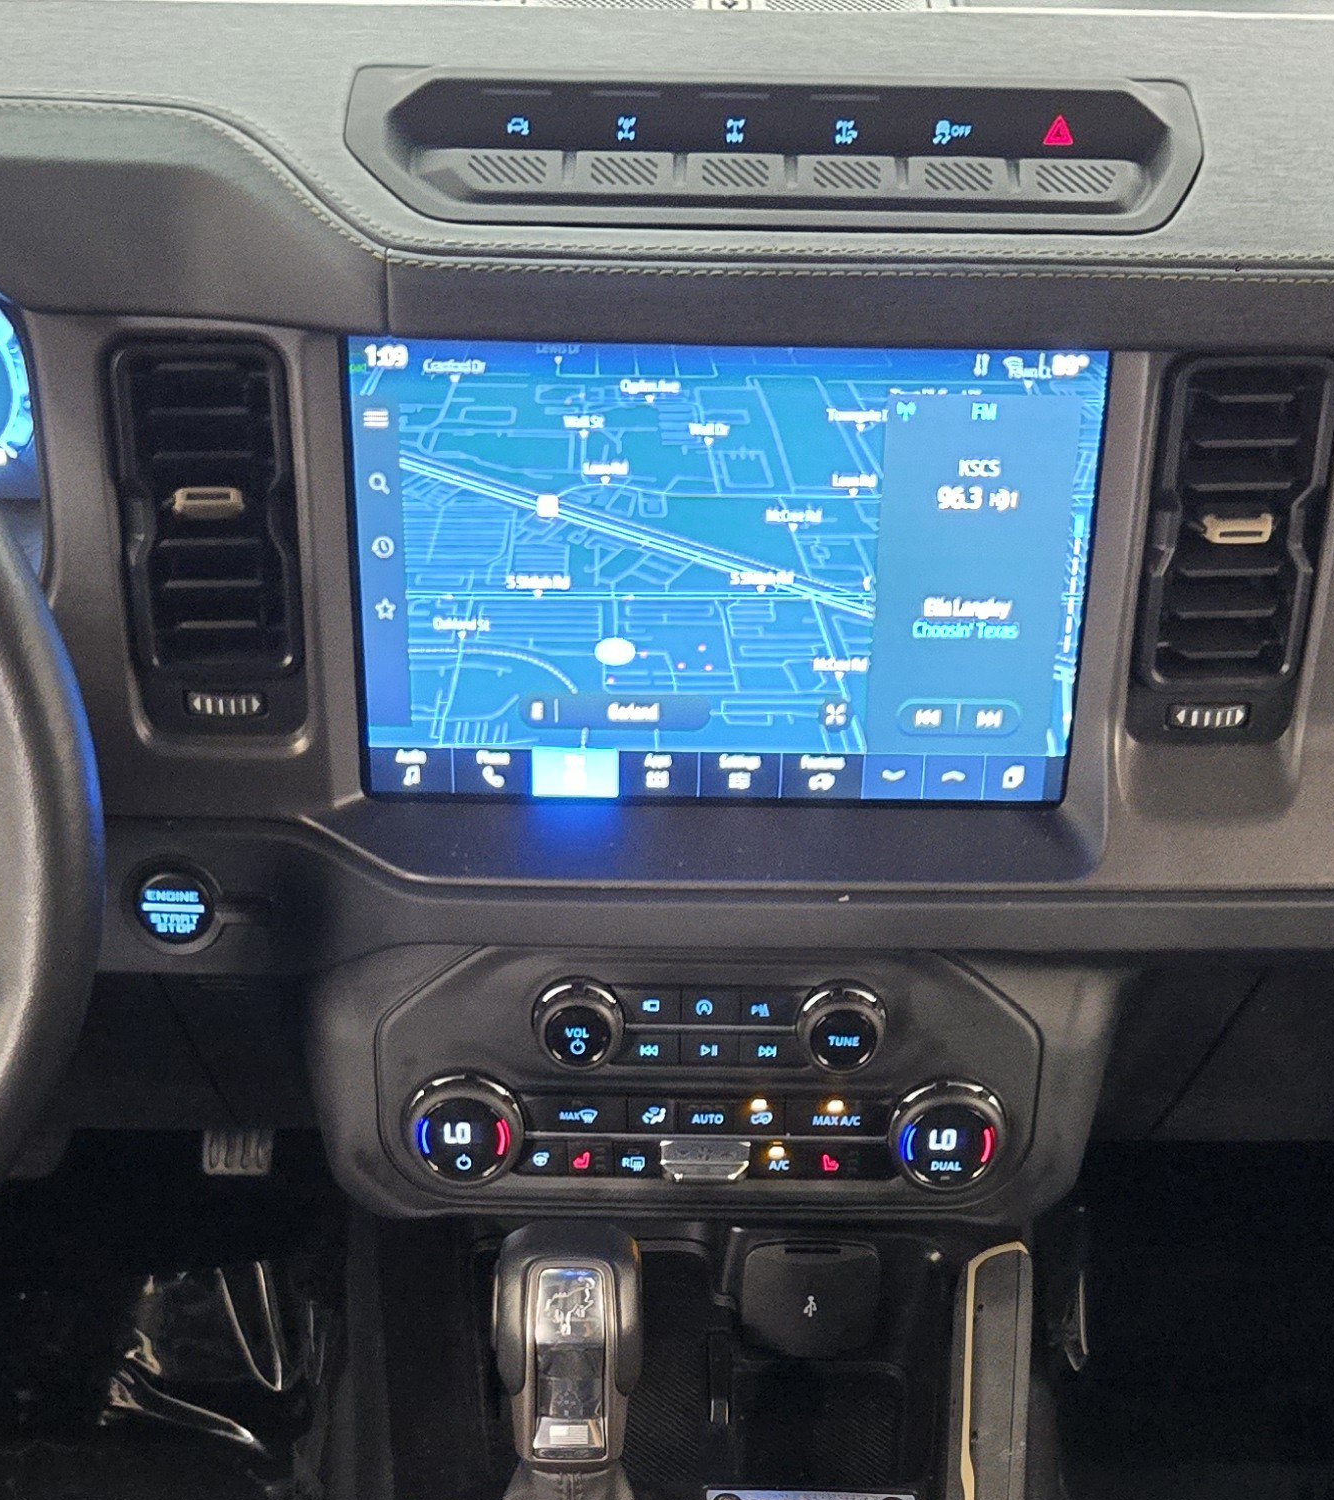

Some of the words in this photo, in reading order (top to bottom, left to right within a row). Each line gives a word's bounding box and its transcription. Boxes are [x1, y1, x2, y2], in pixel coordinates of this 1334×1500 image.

[950, 124, 972, 138] OFF
[364, 343, 409, 369] 1:09
[970, 402, 998, 421] FM
[957, 458, 1001, 478] KSCS
[936, 485, 984, 511] 96.3
[974, 620, 1019, 639] Texas
[144, 889, 200, 903] ENGINE
[565, 1026, 590, 1040] VOL
[827, 1034, 861, 1048] TUNE
[558, 1110, 581, 1122] MAX
[691, 1112, 724, 1126] AUTO
[812, 1115, 841, 1128] MAX
[840, 1115, 861, 1128] A/C
[928, 1128, 958, 1151] LO
[768, 1158, 790, 1172] A/C
[930, 1158, 962, 1172] DUAL
